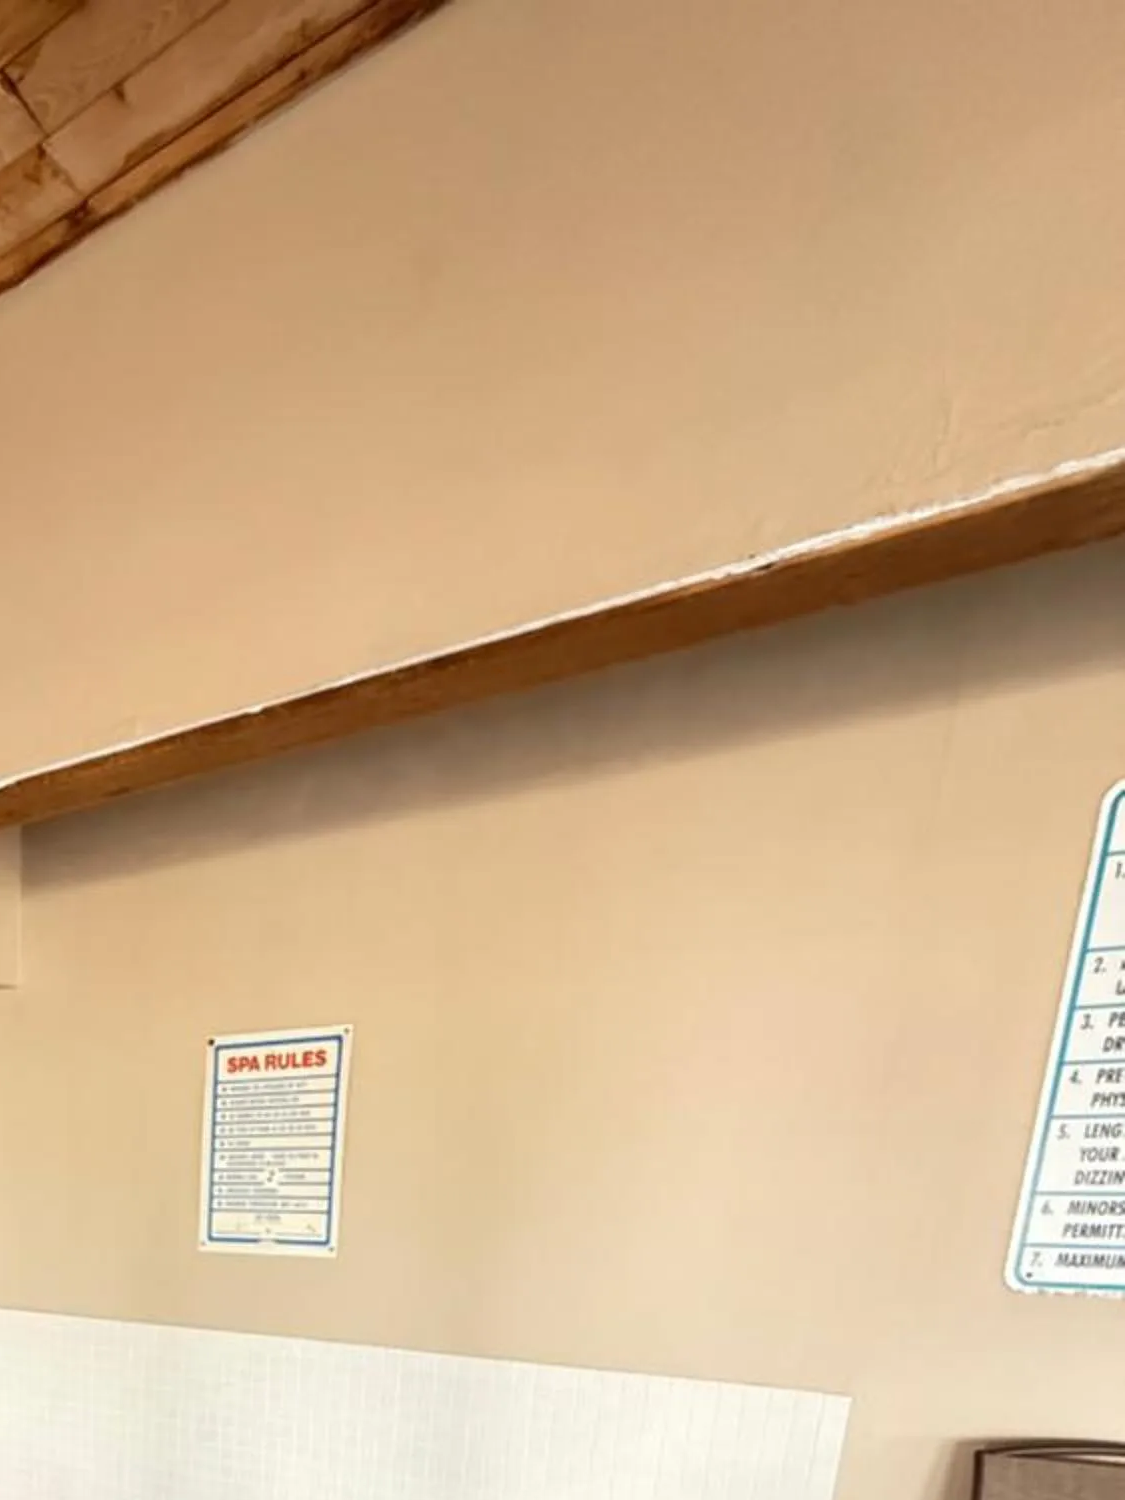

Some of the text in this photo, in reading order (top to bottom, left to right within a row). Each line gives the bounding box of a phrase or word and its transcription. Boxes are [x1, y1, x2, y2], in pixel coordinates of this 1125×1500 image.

[226, 1049, 328, 1074] SPA RULES
[1080, 1147, 1121, 1163] YOUR
[1066, 1200, 1125, 1216] MINORS
